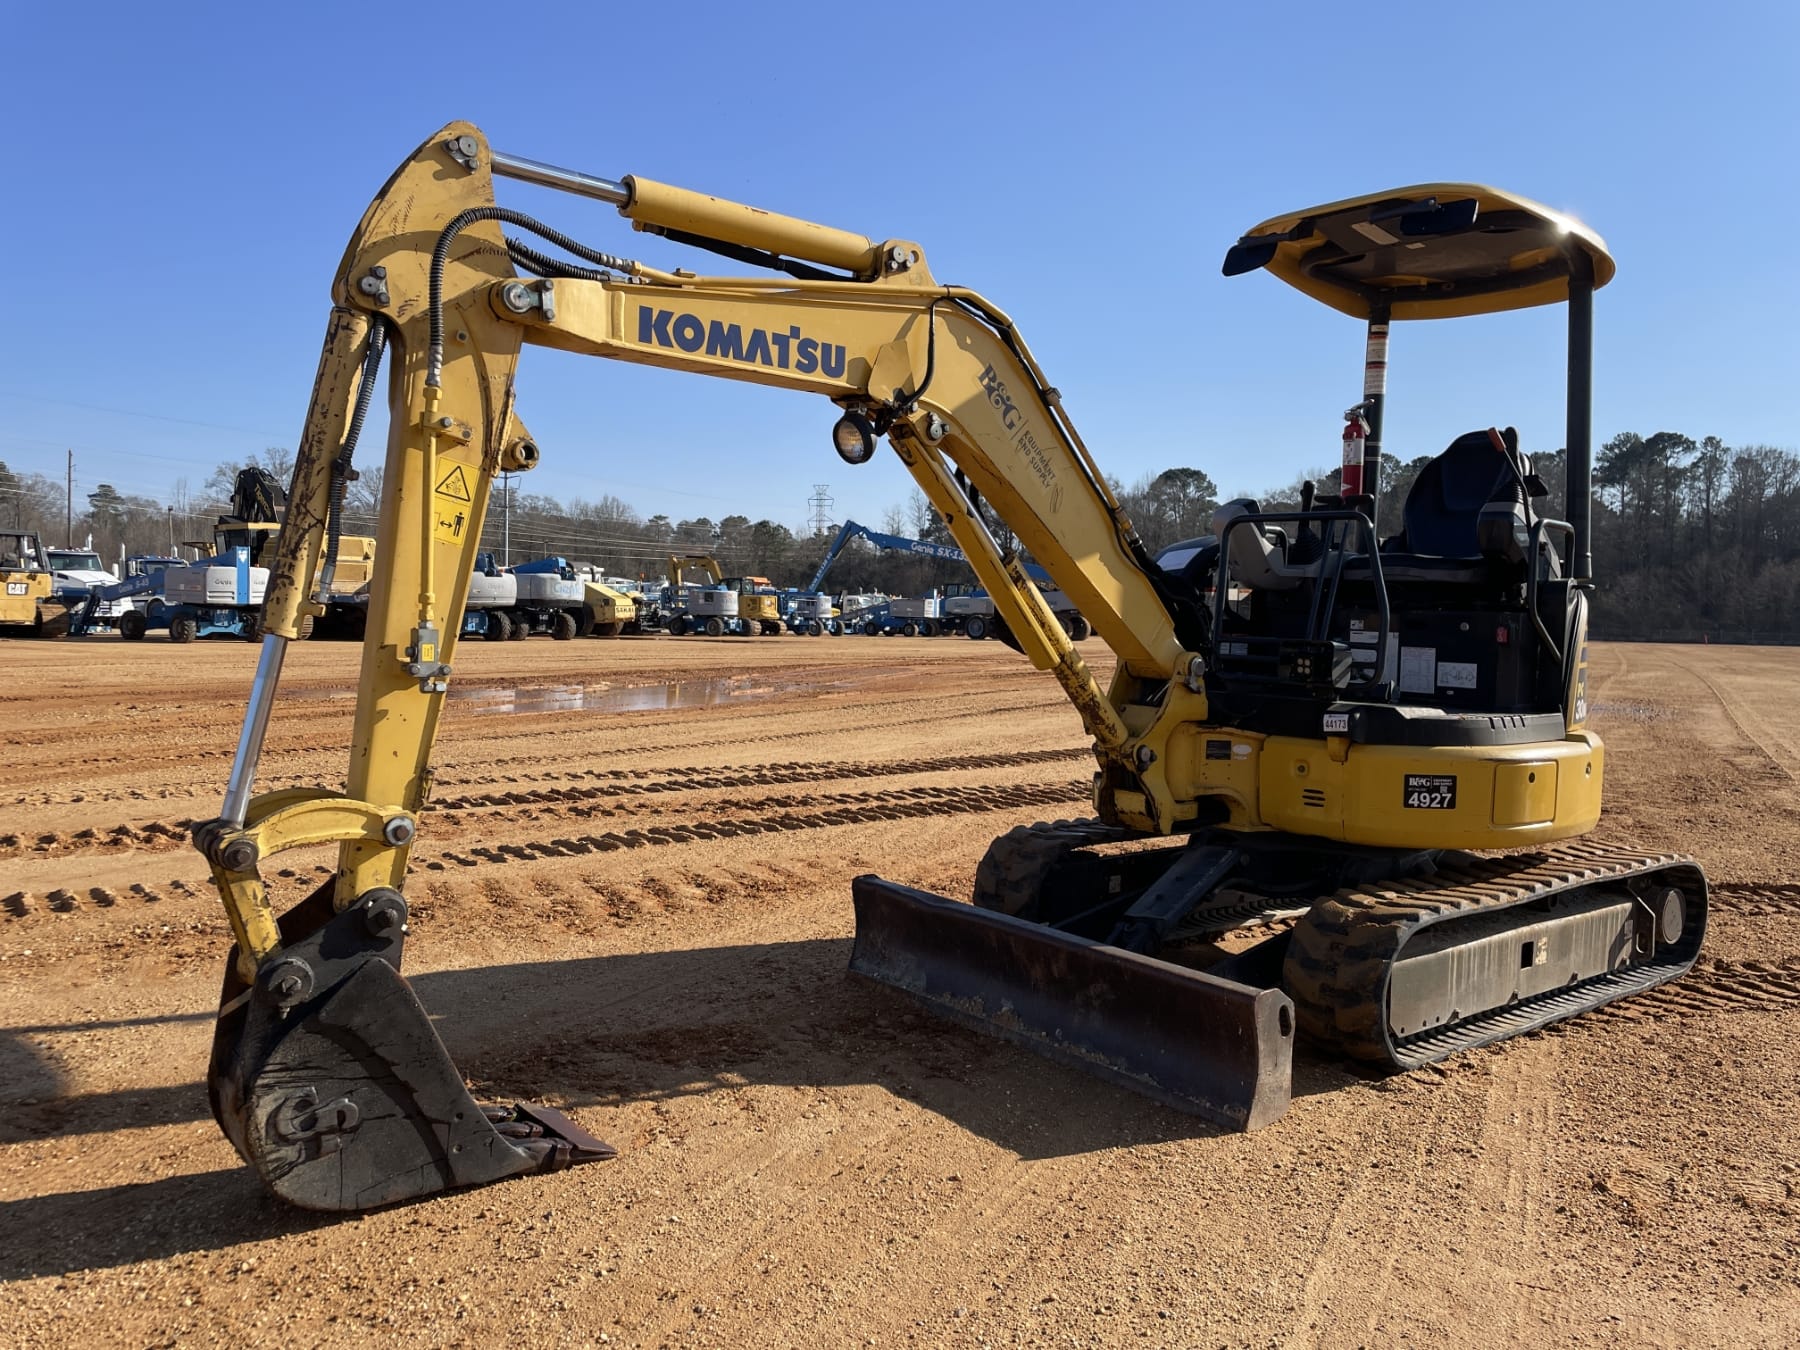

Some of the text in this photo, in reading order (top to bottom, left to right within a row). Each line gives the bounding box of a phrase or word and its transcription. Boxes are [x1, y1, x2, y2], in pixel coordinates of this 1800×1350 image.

[638, 304, 846, 379] KOMATSU
[1018, 437, 1051, 489] AND SUPPLY
[1022, 430, 1056, 481] EQUIPMENT
[911, 541, 969, 561] Genie SX-13
[8, 583, 28, 595] CAT
[214, 578, 232, 586] Genie
[1408, 792, 1452, 807] 4927
